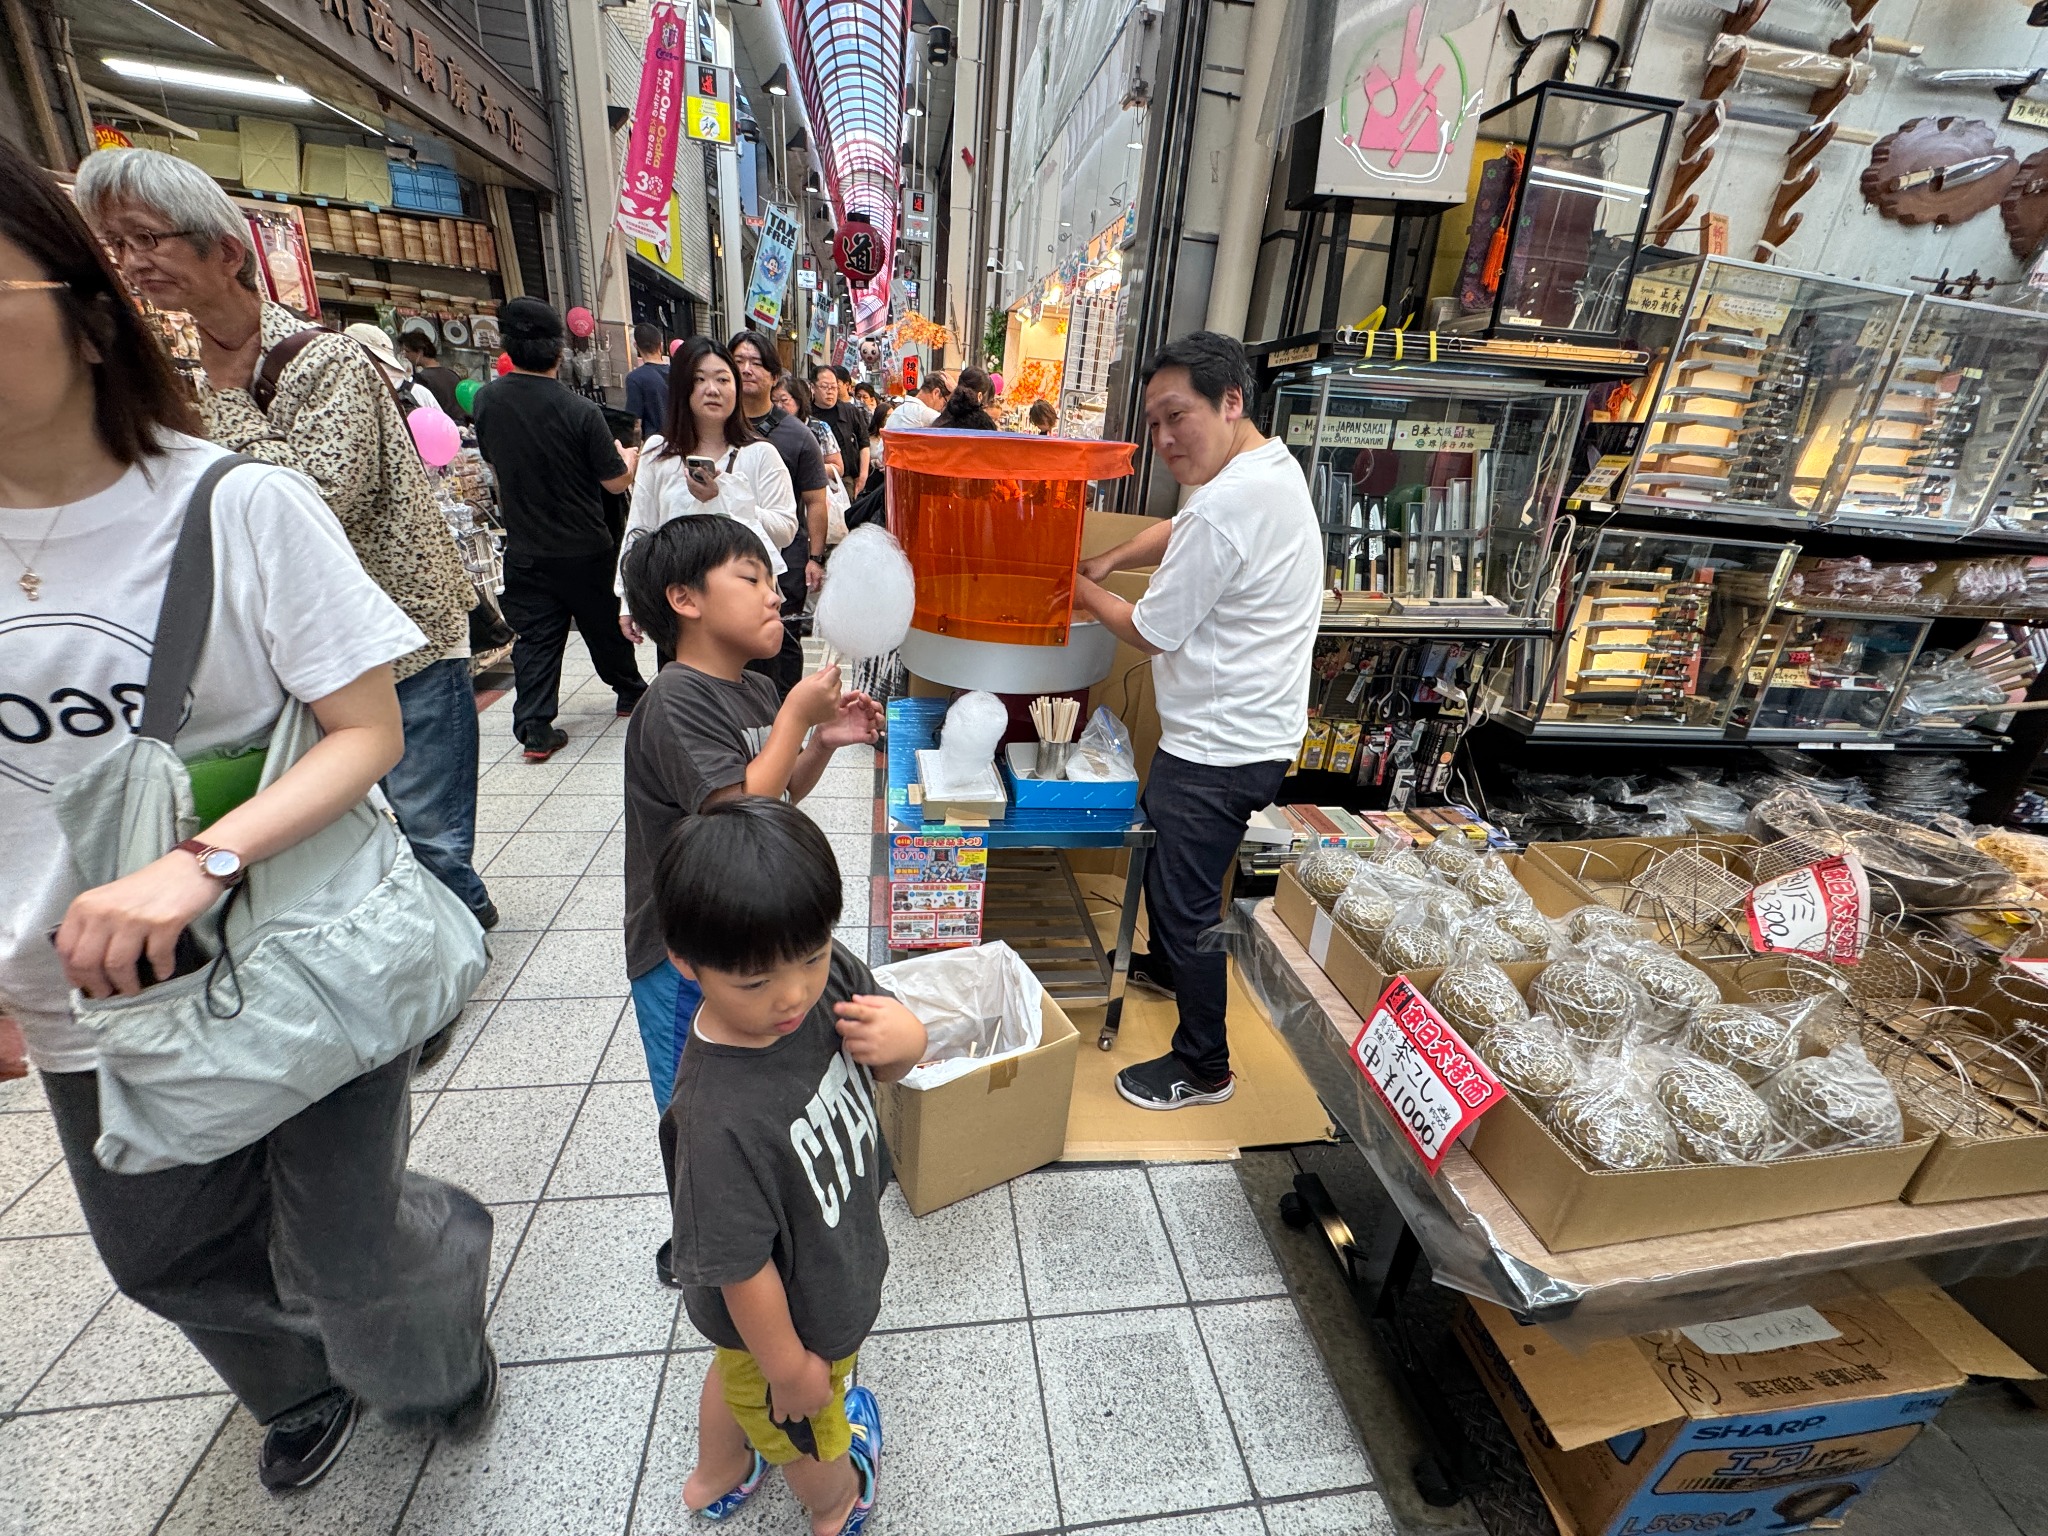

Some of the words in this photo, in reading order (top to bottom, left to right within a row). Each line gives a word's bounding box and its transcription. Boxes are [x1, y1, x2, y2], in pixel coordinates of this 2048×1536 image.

[663, 69, 673, 94] For
[659, 96, 671, 123] Our
[653, 125, 667, 168] Osaka
[770, 212, 798, 238] TAX
[766, 226, 795, 251] FREE
[842, 232, 877, 276] 道
[817, 301, 830, 314] FREE
[818, 293, 831, 307] TAX
[1305, 418, 1325, 432] Mae
[1328, 424, 1335, 432] in
[1336, 421, 1361, 434] JAPAN
[1362, 423, 1387, 435] SAKAI
[1411, 424, 1431, 437] 日本
[1334, 435, 1353, 444] SAKAI
[1354, 437, 1384, 446] TAKAYUKI
[893, 852, 925, 860] 10/10
[1758, 900, 1789, 936] 300
[1399, 1000, 1493, 1107] 本日大特価
[1391, 1035, 1433, 1103] 茶こし
[1692, 1415, 1828, 1441] SHARP
